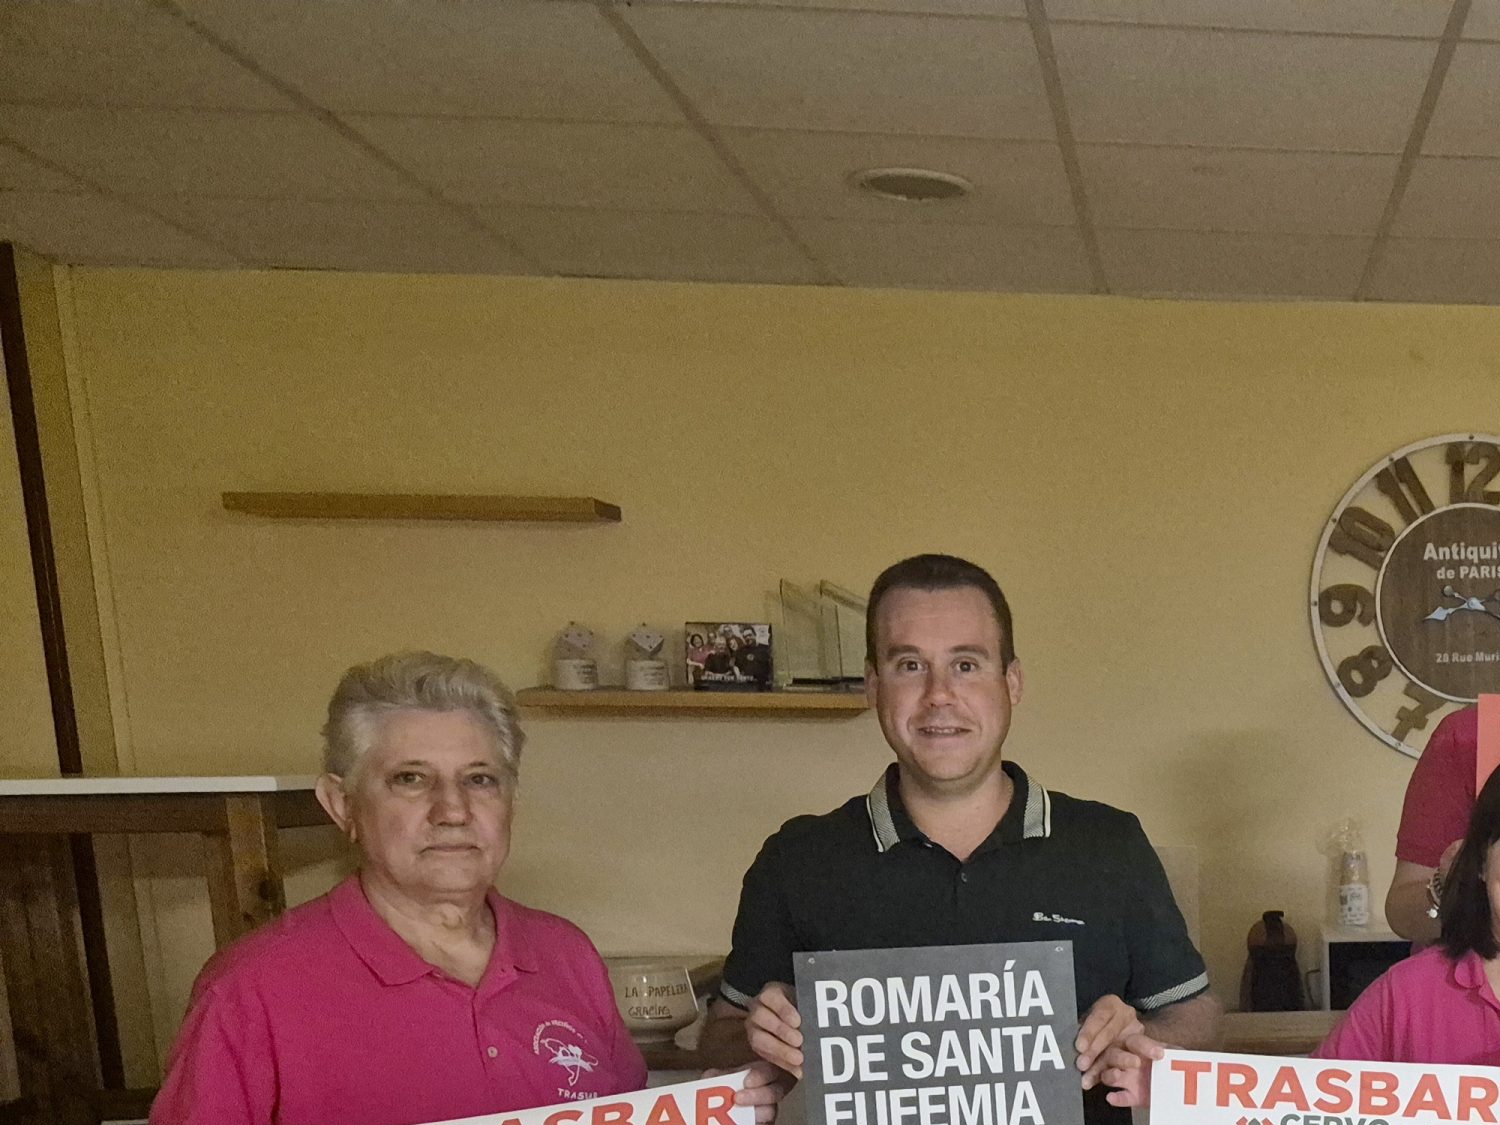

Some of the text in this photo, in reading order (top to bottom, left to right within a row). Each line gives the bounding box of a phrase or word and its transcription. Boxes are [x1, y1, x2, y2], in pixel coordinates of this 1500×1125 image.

[1375, 456, 1435, 525] 11
[1328, 507, 1396, 570] 10
[1437, 566, 1455, 579] de
[1318, 584, 1376, 628] 9
[1337, 645, 1393, 698] 8
[1452, 653, 1473, 662] Rue
[626, 987, 638, 998] LA
[815, 959, 1054, 1028] ROMARÍA
[820, 1025, 1066, 1084] DE SANTA
[1170, 1059, 1498, 1123] TRASBAR
